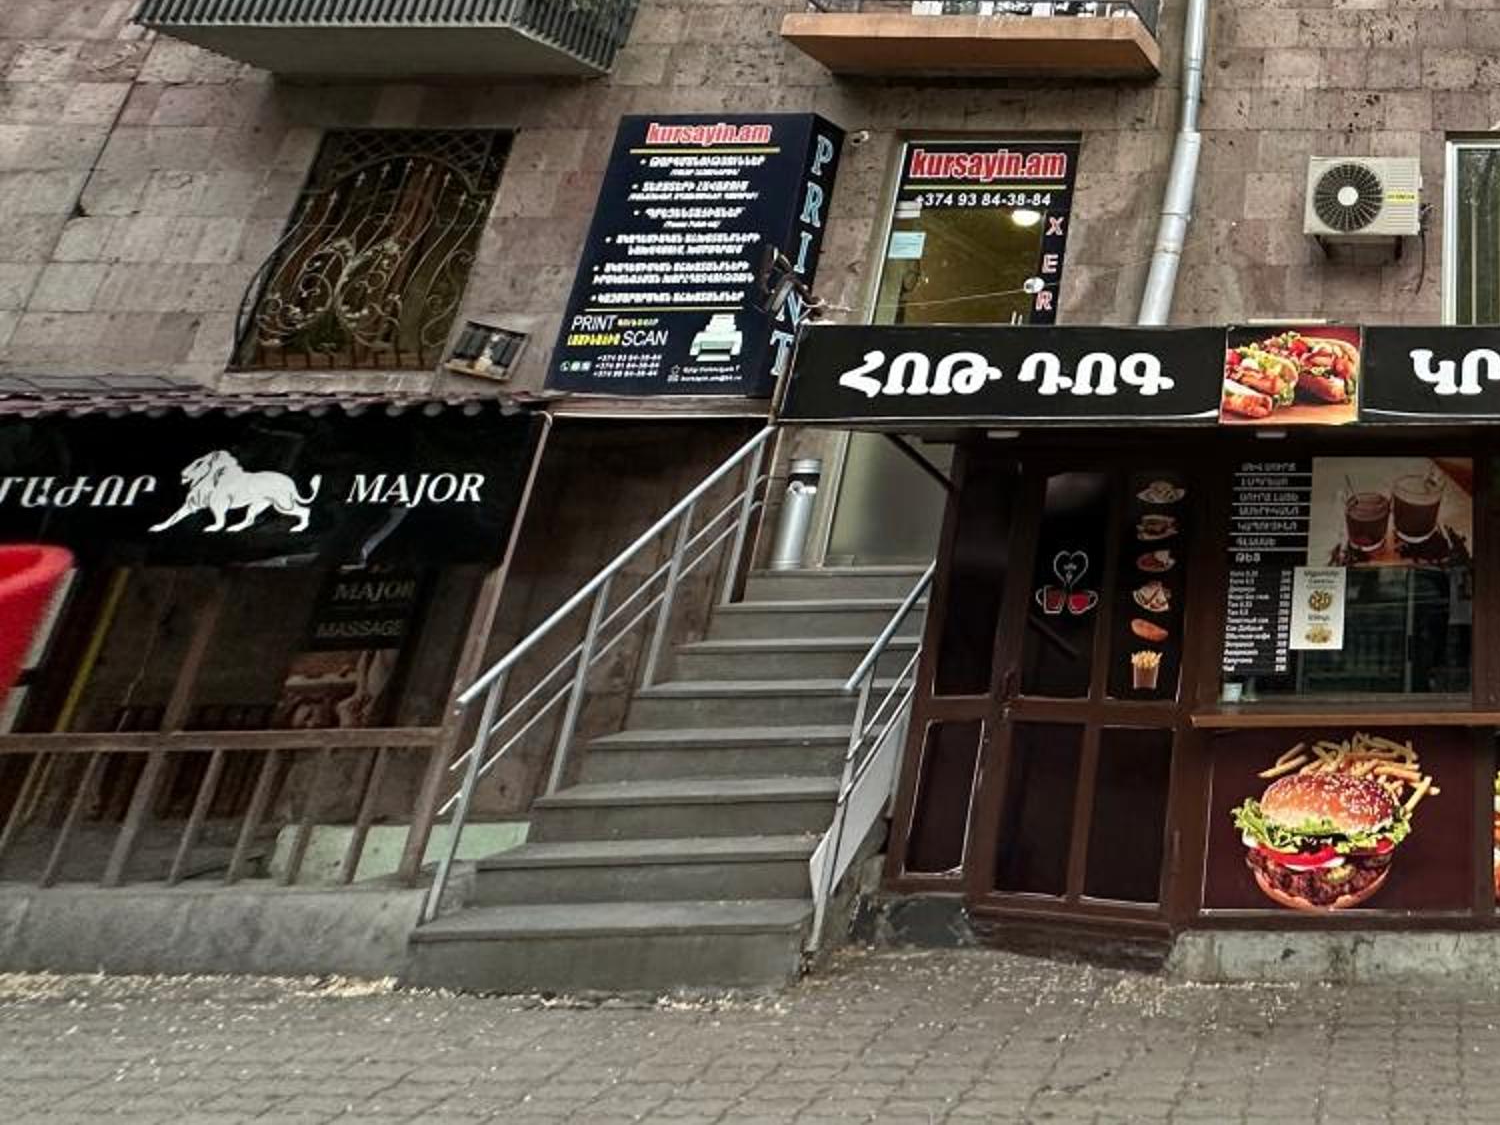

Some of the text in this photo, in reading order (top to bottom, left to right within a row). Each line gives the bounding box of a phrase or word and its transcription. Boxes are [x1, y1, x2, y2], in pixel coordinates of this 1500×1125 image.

[646, 122, 772, 146] kursayin.am
[909, 148, 1068, 183] kursayin.am
[957, 193, 977, 206] 93
[980, 192, 1052, 207] 84-38-84
[571, 314, 617, 332] PRINT
[621, 329, 669, 347] SCAN
[838, 350, 1176, 399] ՀՈԹ ԴՈԳ
[345, 472, 487, 506] MAJOR
